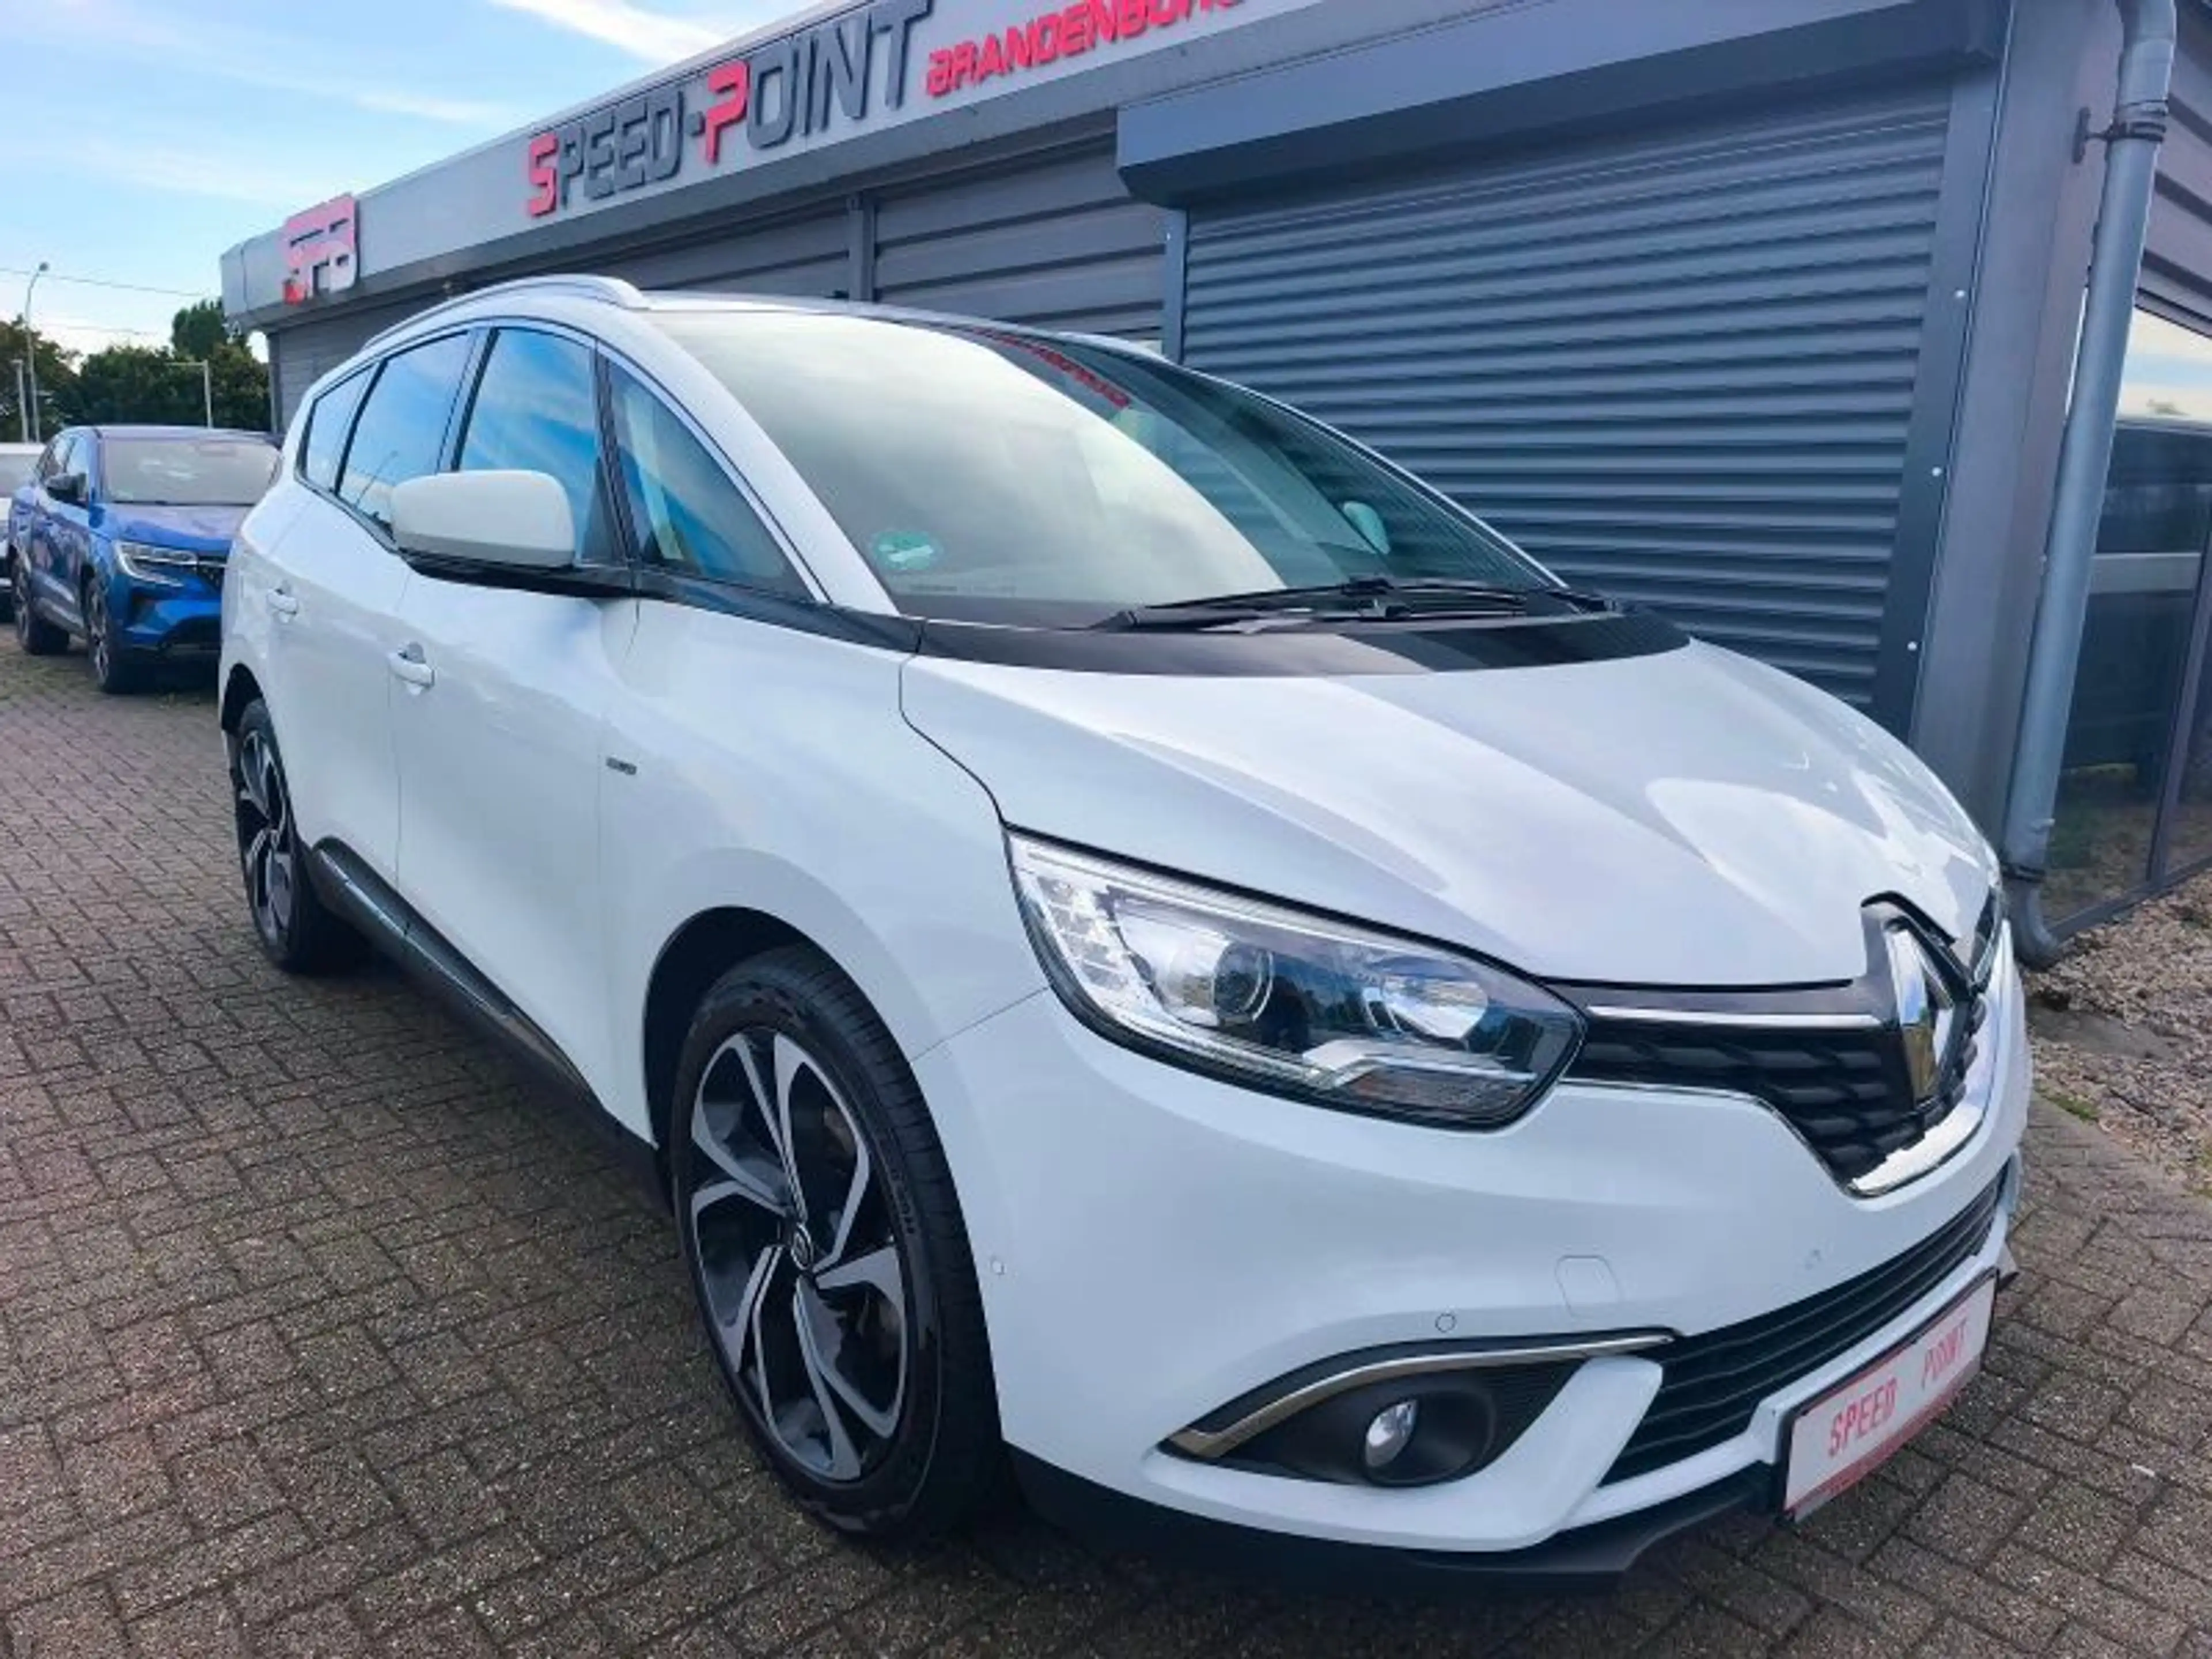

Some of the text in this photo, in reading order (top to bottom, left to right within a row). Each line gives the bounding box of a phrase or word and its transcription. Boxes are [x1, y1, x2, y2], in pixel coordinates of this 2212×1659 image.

[926, 0, 1244, 98] BRANDENBU
[1828, 1316, 1968, 1457] SPEED POINT
